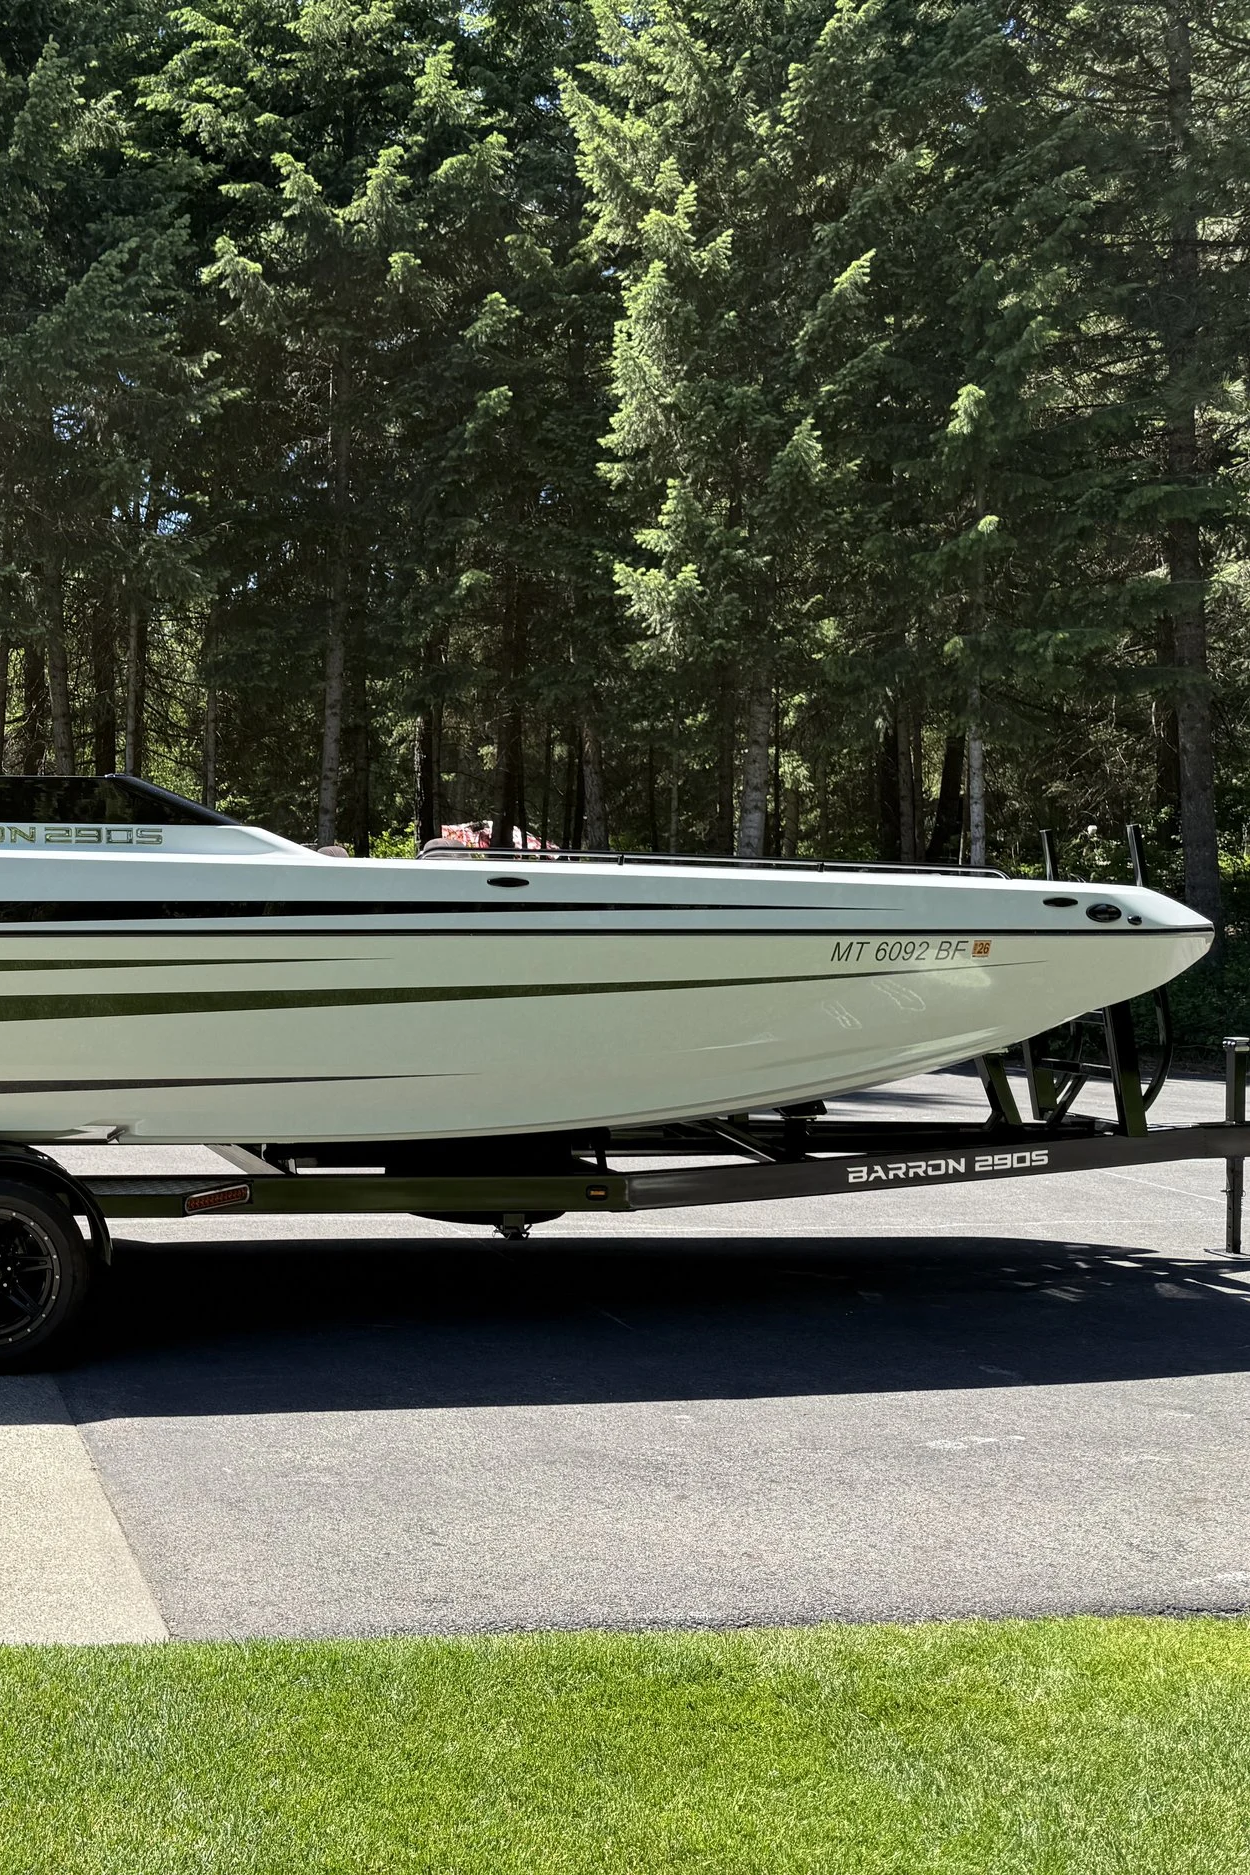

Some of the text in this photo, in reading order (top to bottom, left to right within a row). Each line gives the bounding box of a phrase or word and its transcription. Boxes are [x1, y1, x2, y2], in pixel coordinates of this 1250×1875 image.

[830, 941, 870, 962] MT
[875, 941, 930, 962] 6092
[935, 940, 969, 961] BF
[976, 942, 990, 955] 26
[846, 1157, 966, 1183] BARRON
